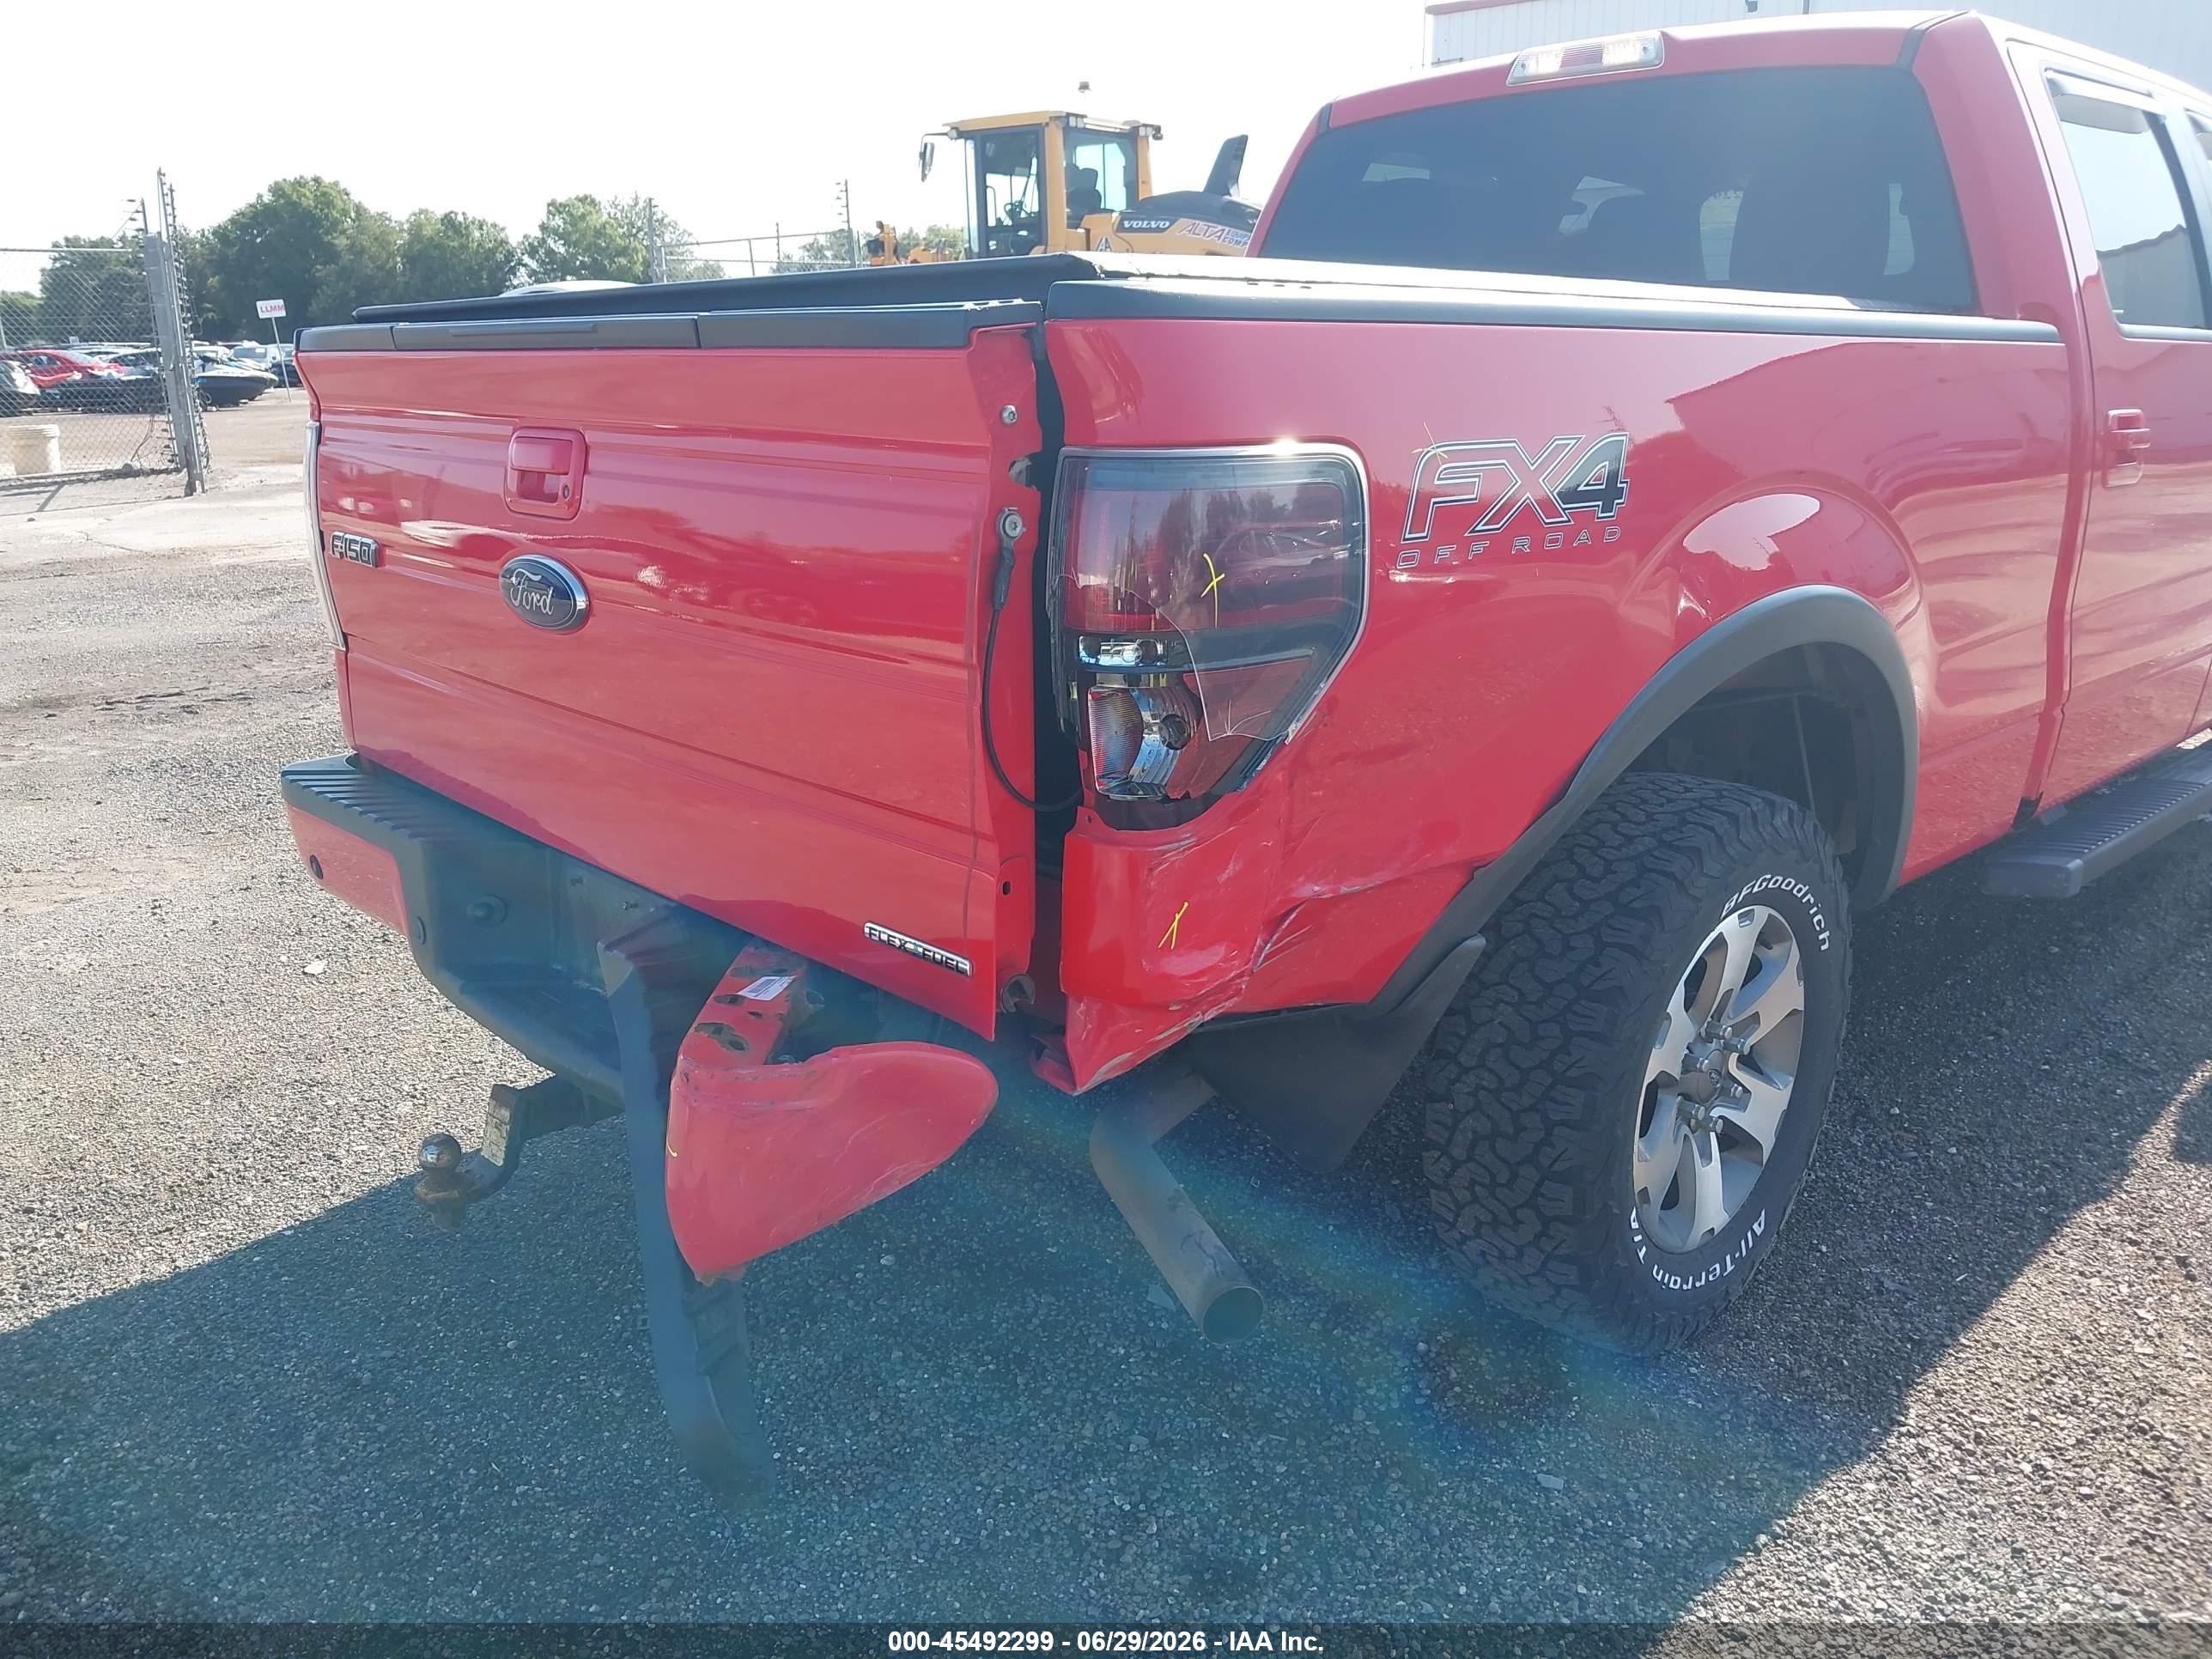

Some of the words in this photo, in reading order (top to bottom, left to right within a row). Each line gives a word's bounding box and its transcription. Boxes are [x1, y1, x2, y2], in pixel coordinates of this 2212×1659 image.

[1123, 220, 1170, 228] VOLVO
[1178, 221, 1224, 243] ALTA
[1401, 432, 1630, 543] FX4
[1396, 540, 1490, 568] OFF
[1511, 526, 1621, 554] ROAD
[510, 568, 554, 616] Ford
[1720, 873, 1832, 951] BFGoodrich
[867, 925, 906, 950] FLEX
[921, 947, 970, 976] FUEL
[1651, 1206, 1766, 1291] All-Terrain
